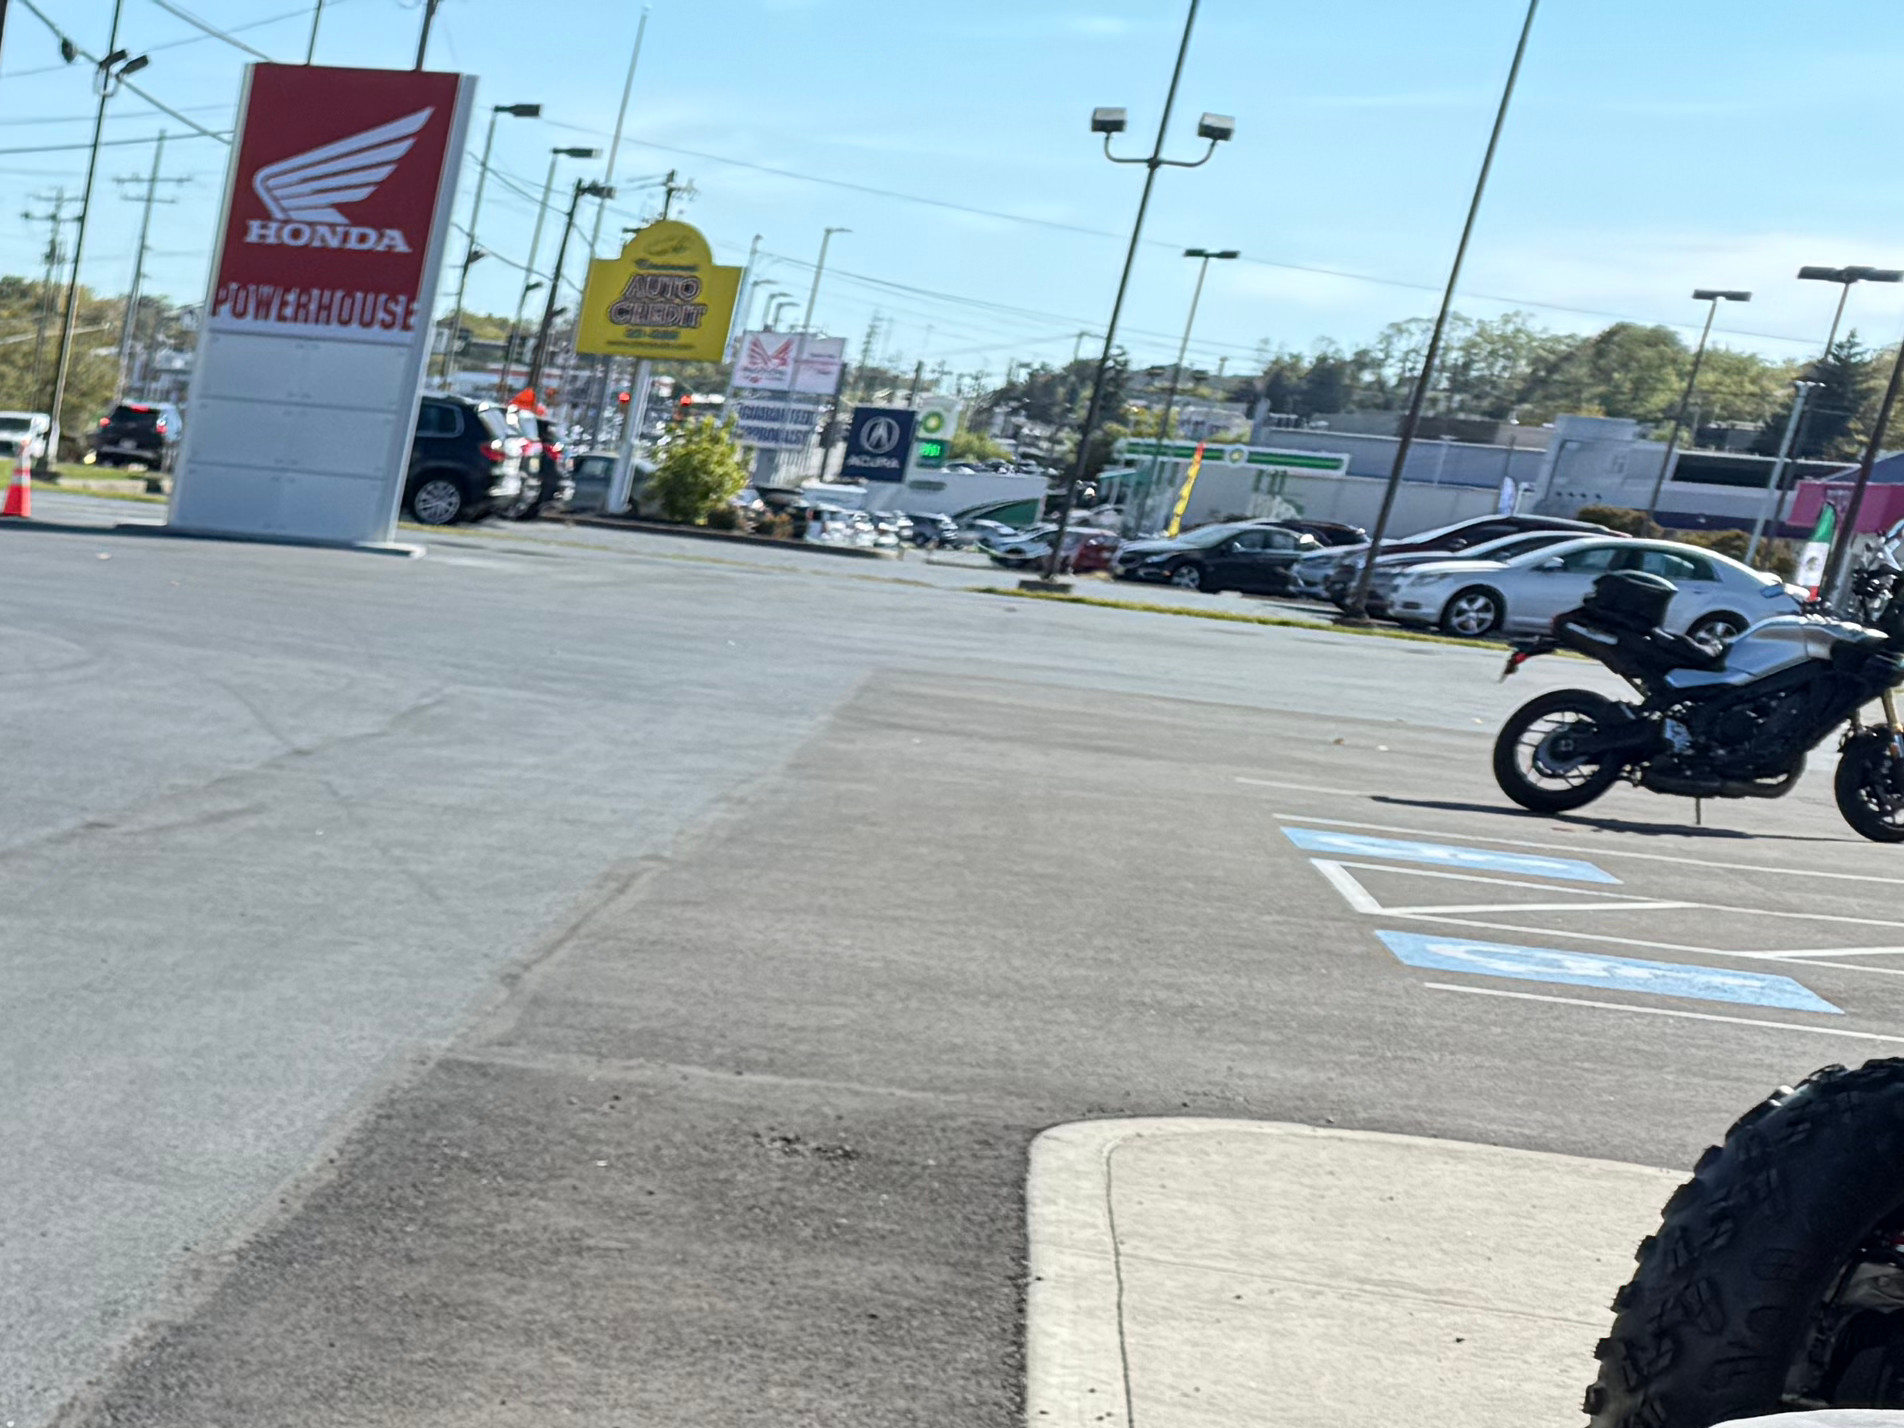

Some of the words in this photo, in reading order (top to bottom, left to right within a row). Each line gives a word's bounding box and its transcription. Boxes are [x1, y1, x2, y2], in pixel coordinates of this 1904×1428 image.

[245, 219, 412, 253] HONDA
[620, 273, 703, 301] AUTO
[211, 283, 418, 331] POWERHOUSE
[607, 300, 708, 328] CREDIT
[845, 454, 900, 468] ACURA
